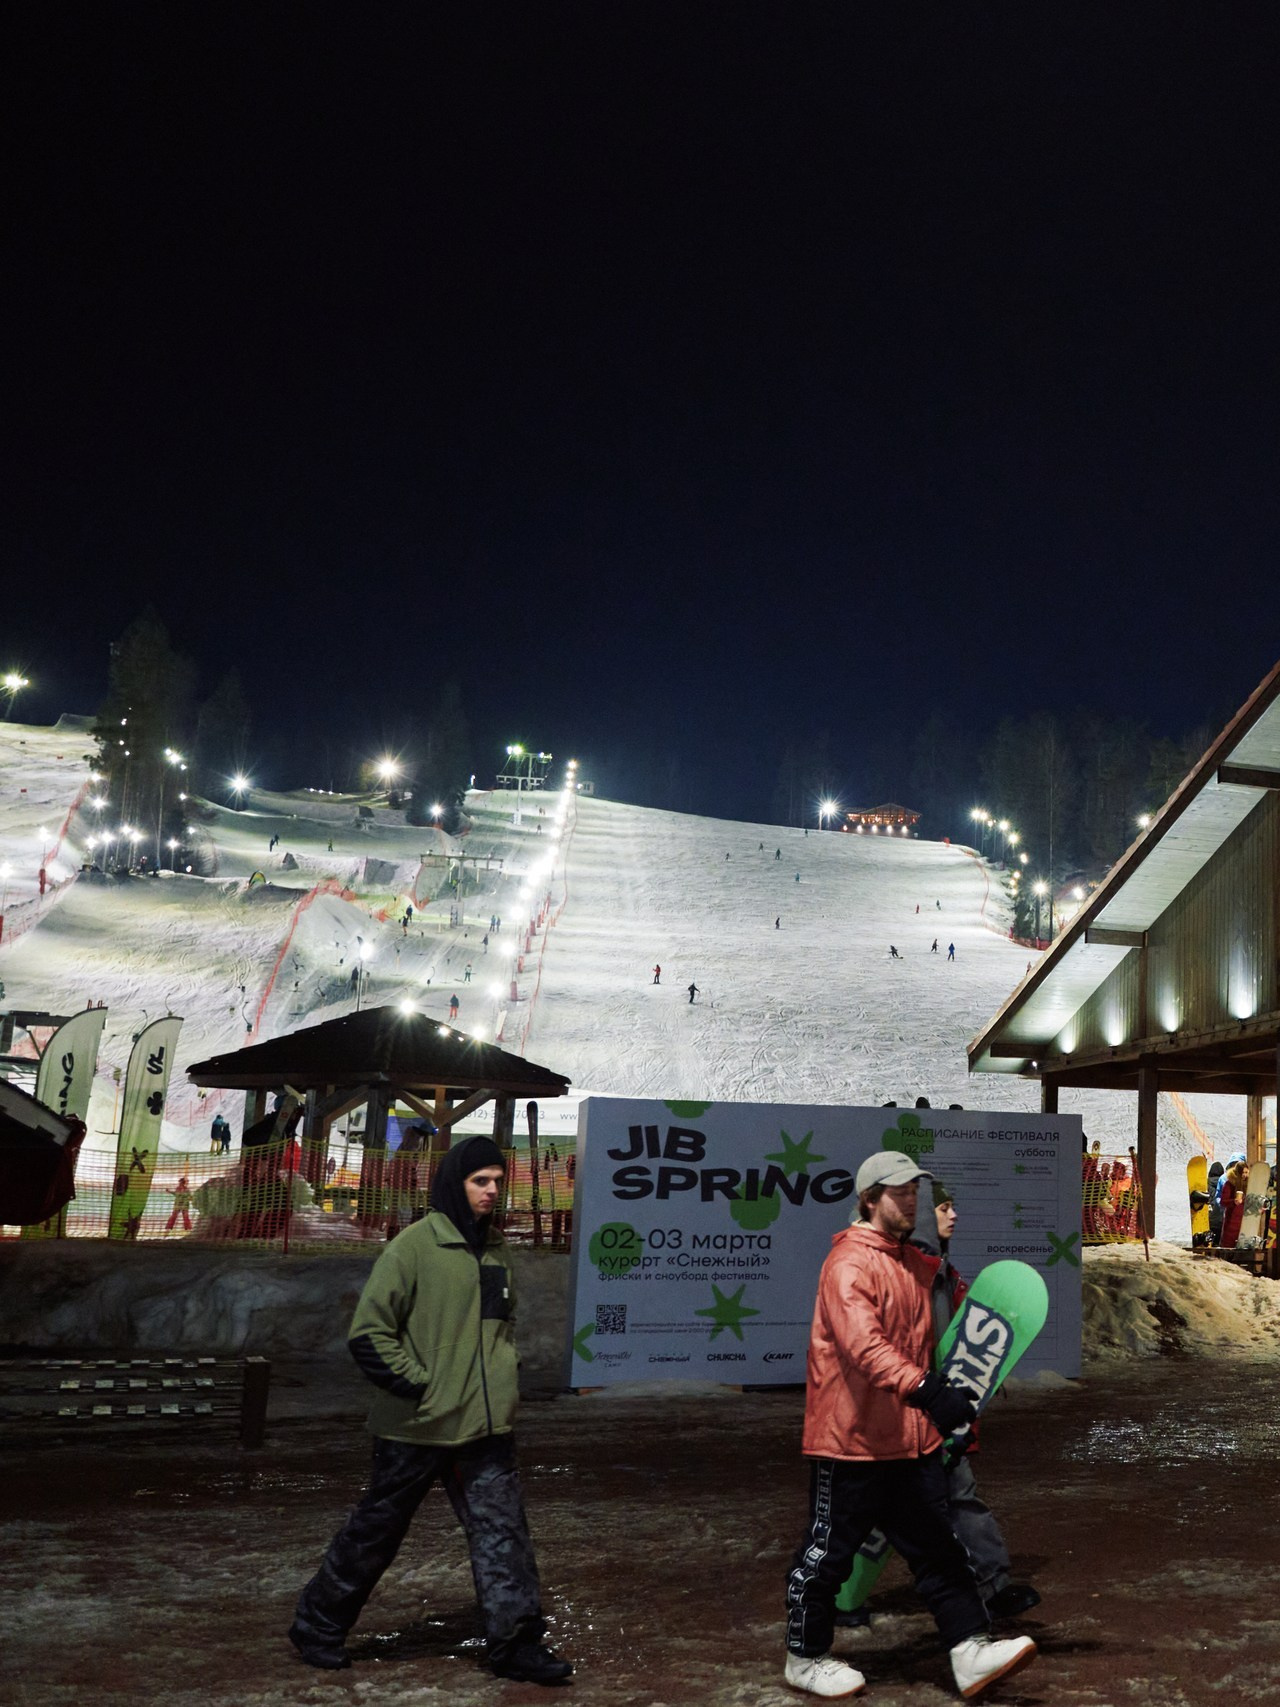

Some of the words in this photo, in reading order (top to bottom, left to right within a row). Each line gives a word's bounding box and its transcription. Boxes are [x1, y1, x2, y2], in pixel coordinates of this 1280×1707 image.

[901, 1127, 984, 1139] РАСПИСАНИЕ
[987, 1130, 1060, 1142] ФЕСТИВАЛЯ
[607, 1125, 706, 1162] JIB
[904, 1144, 935, 1154] 02.03
[1014, 1148, 1056, 1158] суббота
[612, 1165, 855, 1206] SPRING
[600, 1228, 683, 1249] 02-03
[692, 1233, 772, 1254] марта
[987, 1244, 1054, 1255] воскресенье
[599, 1255, 661, 1270] курорт
[667, 1253, 770, 1268] «Снежный»
[598, 1271, 641, 1282] фриски
[645, 1273, 652, 1281] и
[655, 1271, 709, 1282] сноуборд
[711, 1272, 770, 1282] фестиваль
[706, 1353, 747, 1362] CHUKCHA
